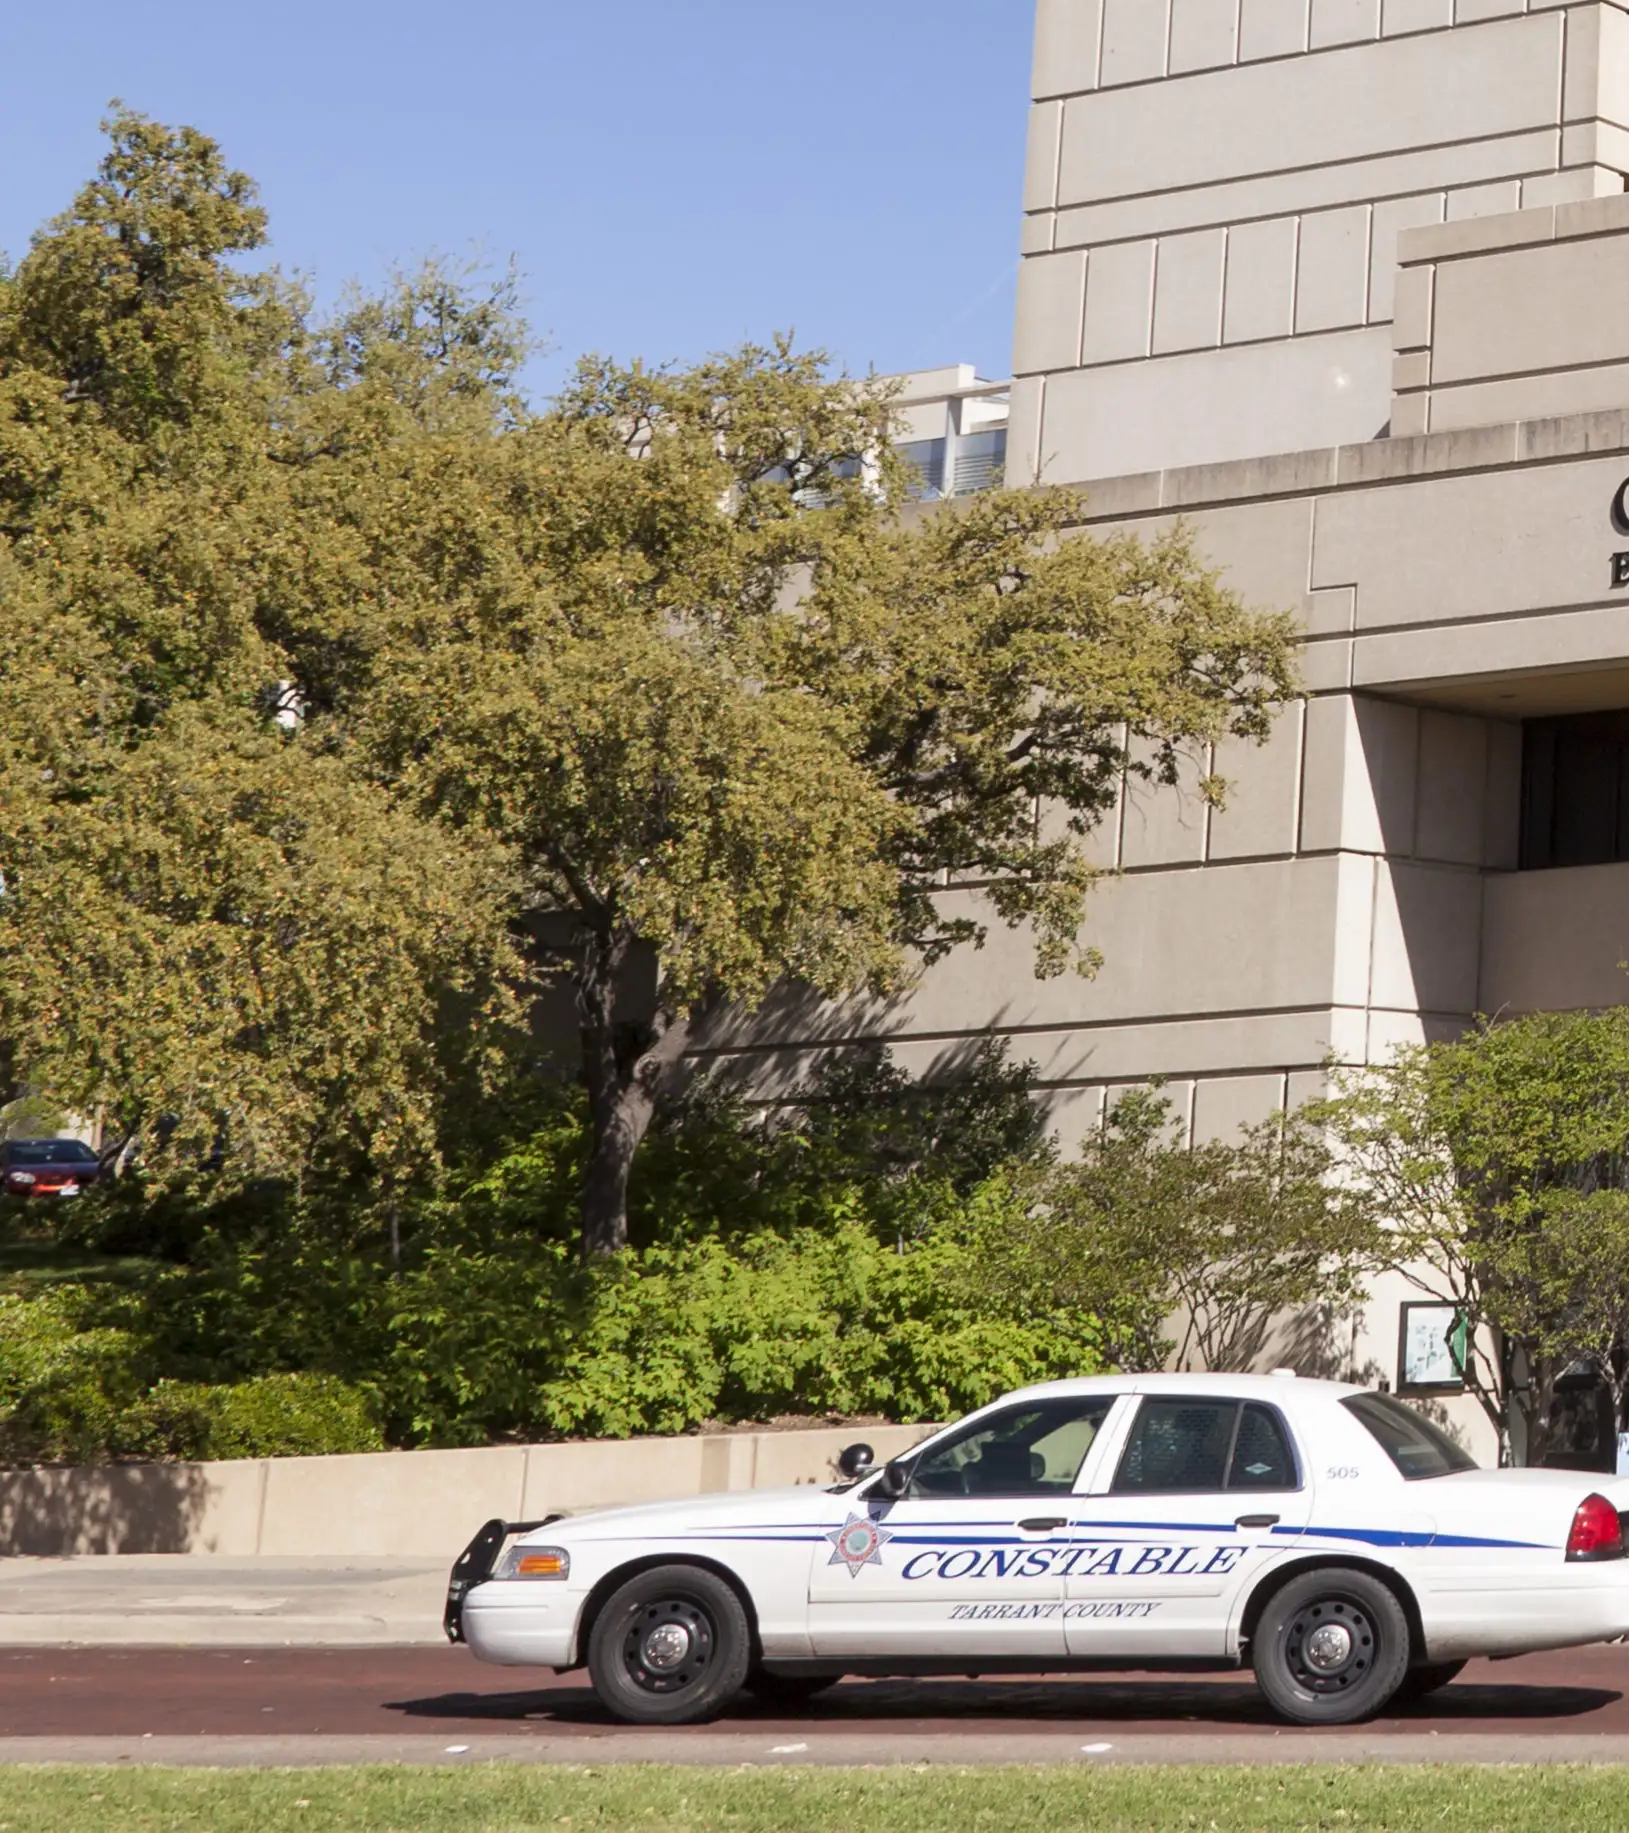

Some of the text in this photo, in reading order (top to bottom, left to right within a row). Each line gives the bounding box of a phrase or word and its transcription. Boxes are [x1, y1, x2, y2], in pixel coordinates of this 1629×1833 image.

[1325, 1466, 1360, 1480] 505
[901, 1546, 1245, 1581] CONSTABLE
[947, 1602, 1162, 1621] TARRANT COUNTY
